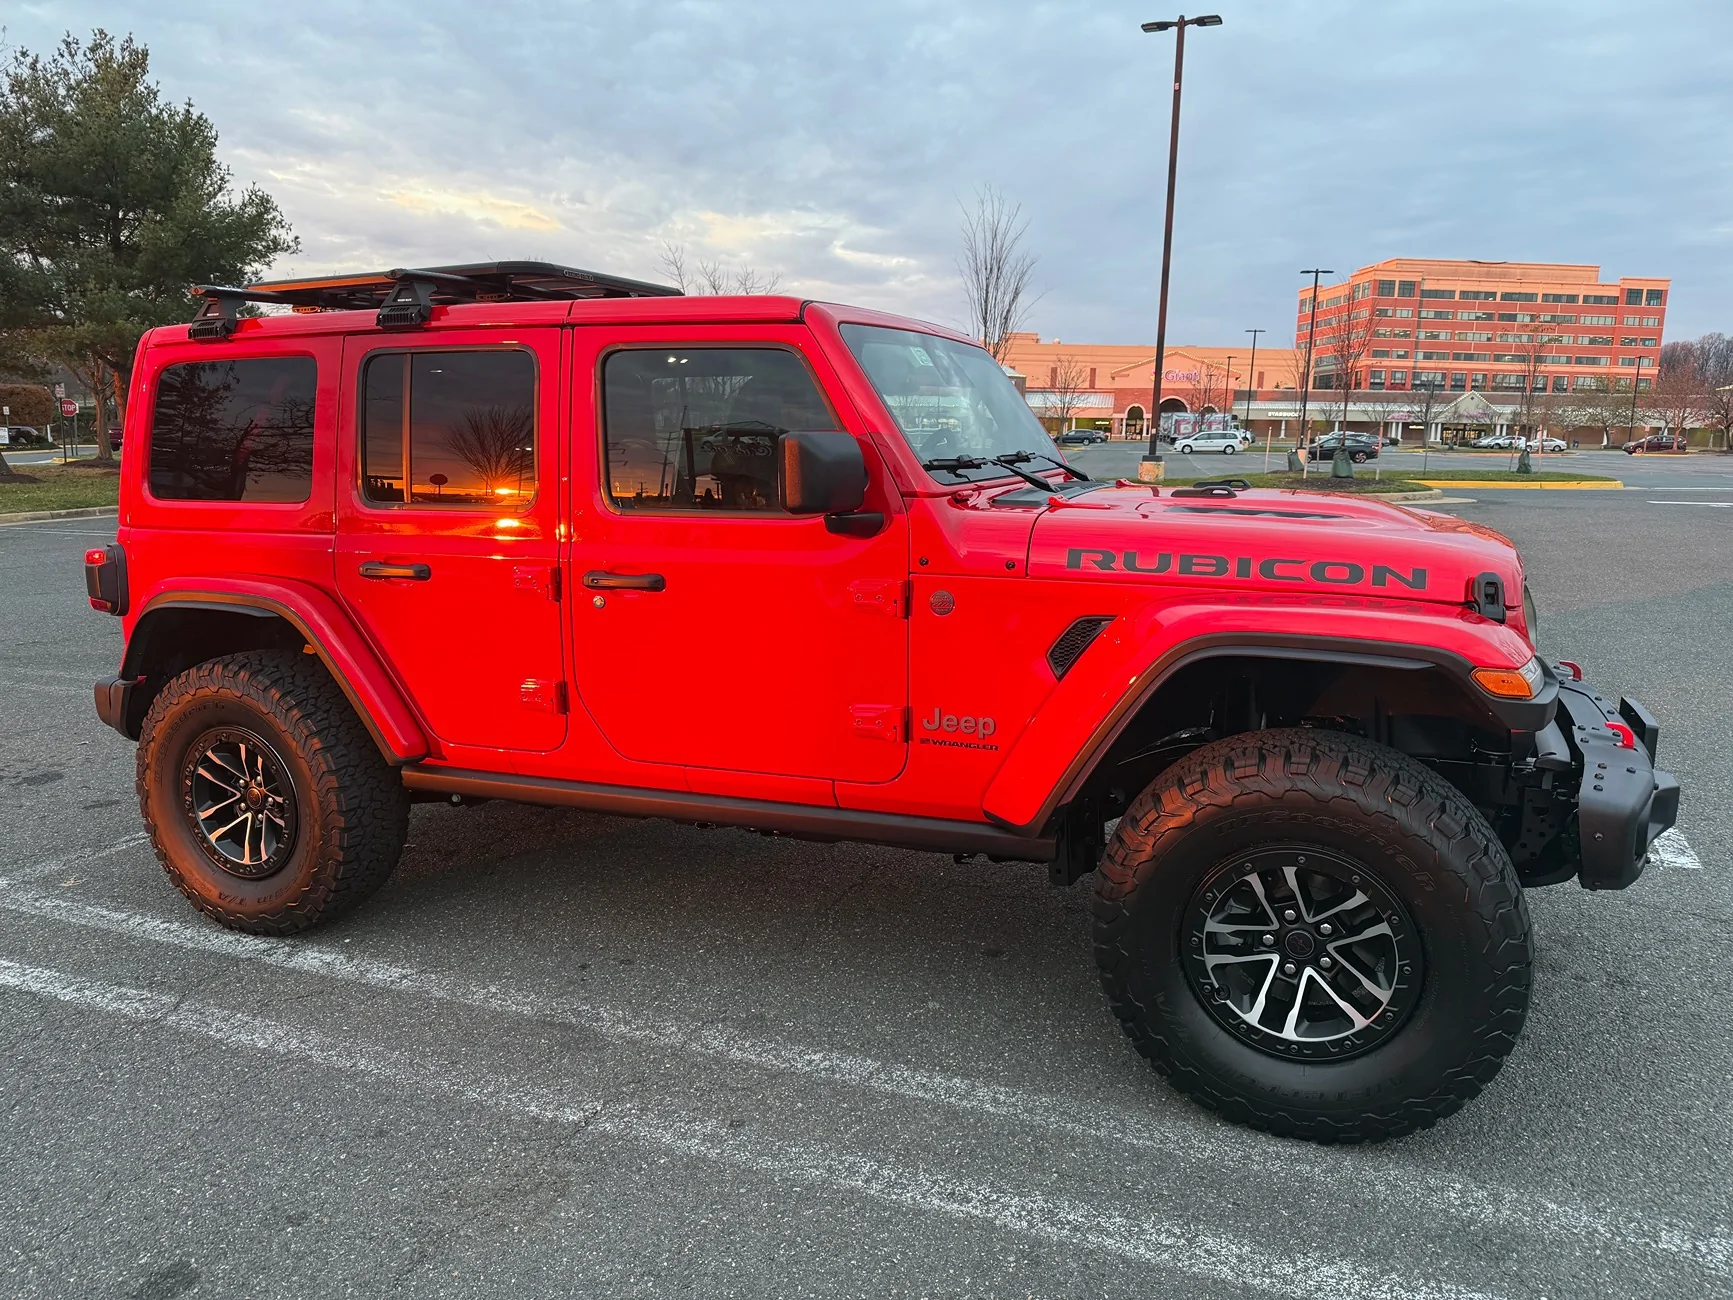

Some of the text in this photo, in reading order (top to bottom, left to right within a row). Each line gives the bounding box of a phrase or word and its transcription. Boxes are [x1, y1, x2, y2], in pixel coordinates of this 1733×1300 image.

[1164, 369, 1199, 381] Giant
[62, 404, 76, 412] STOP
[1065, 548, 1428, 591] RUBICON
[922, 707, 996, 740] Jeep
[931, 739, 1000, 752] WRANGLER
